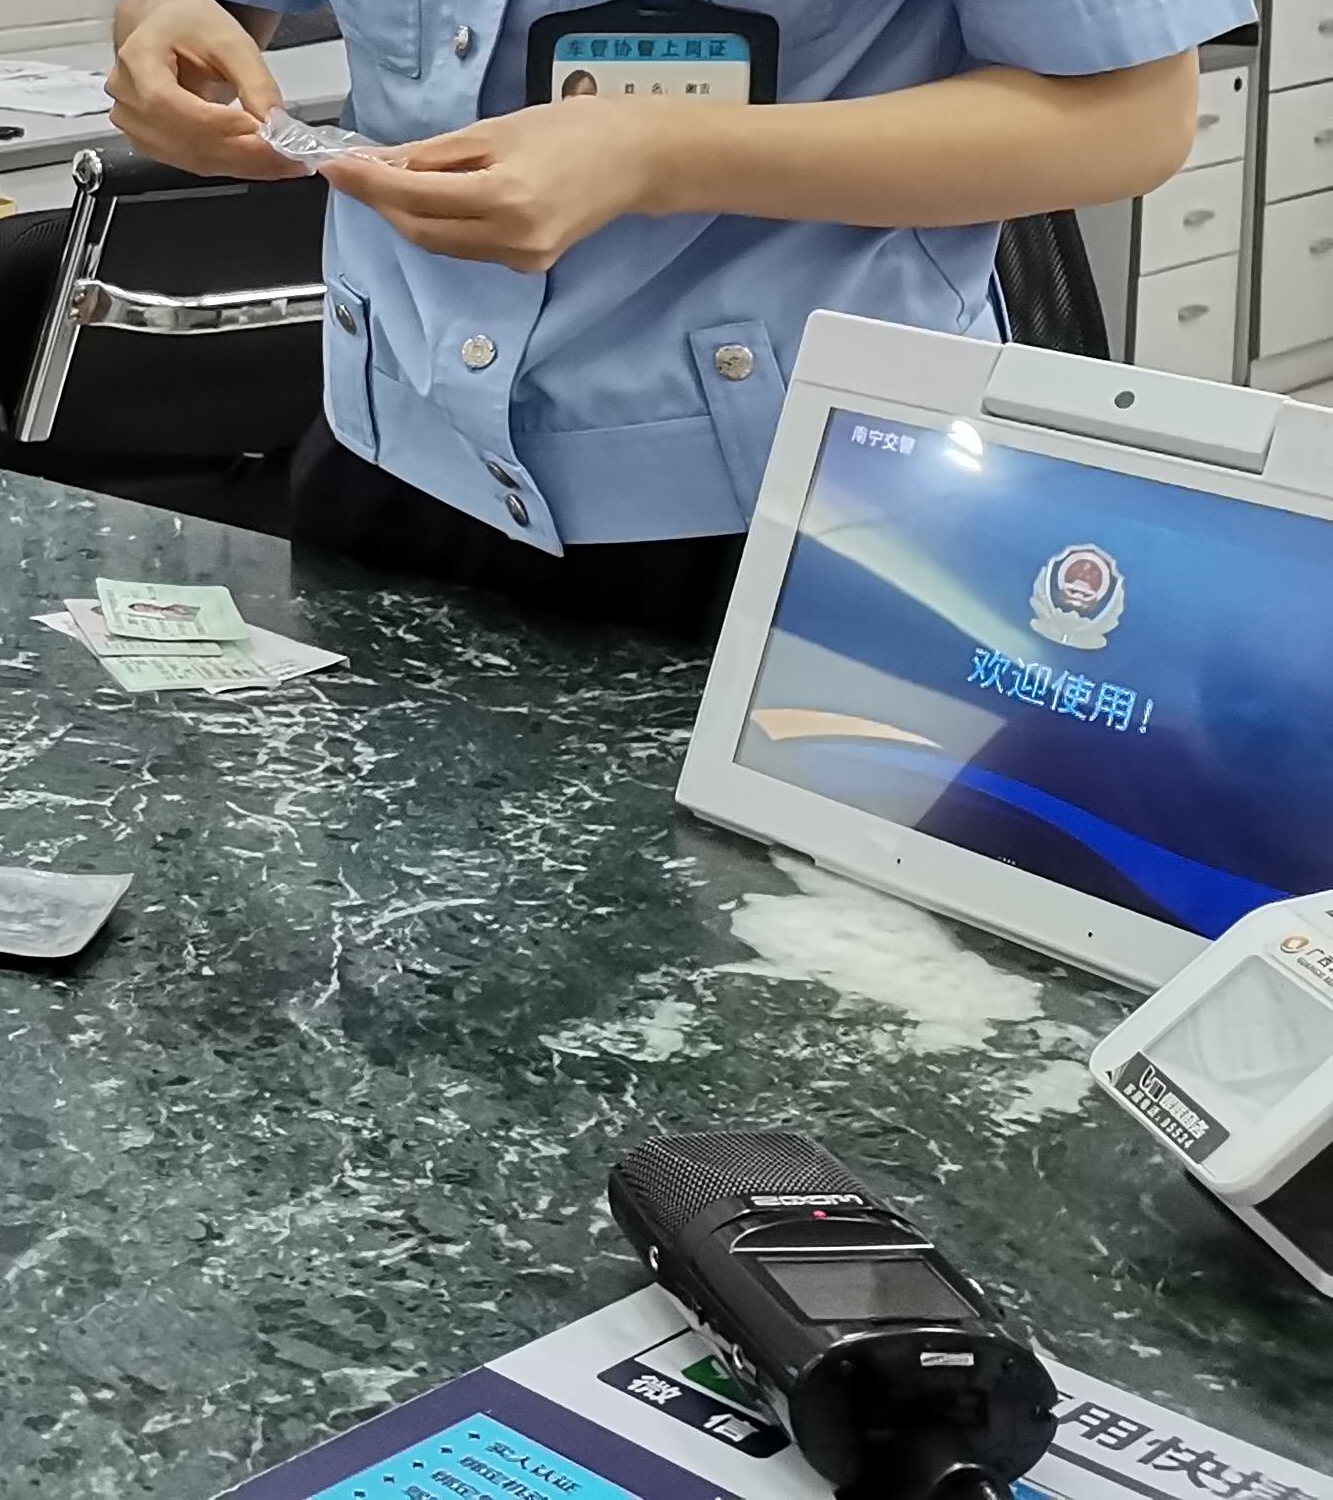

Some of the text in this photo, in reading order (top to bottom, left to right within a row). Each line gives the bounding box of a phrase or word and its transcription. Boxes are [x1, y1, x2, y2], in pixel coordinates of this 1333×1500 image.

[852, 425, 916, 455] 南宁交警
[628, 1375, 759, 1443] 微信
